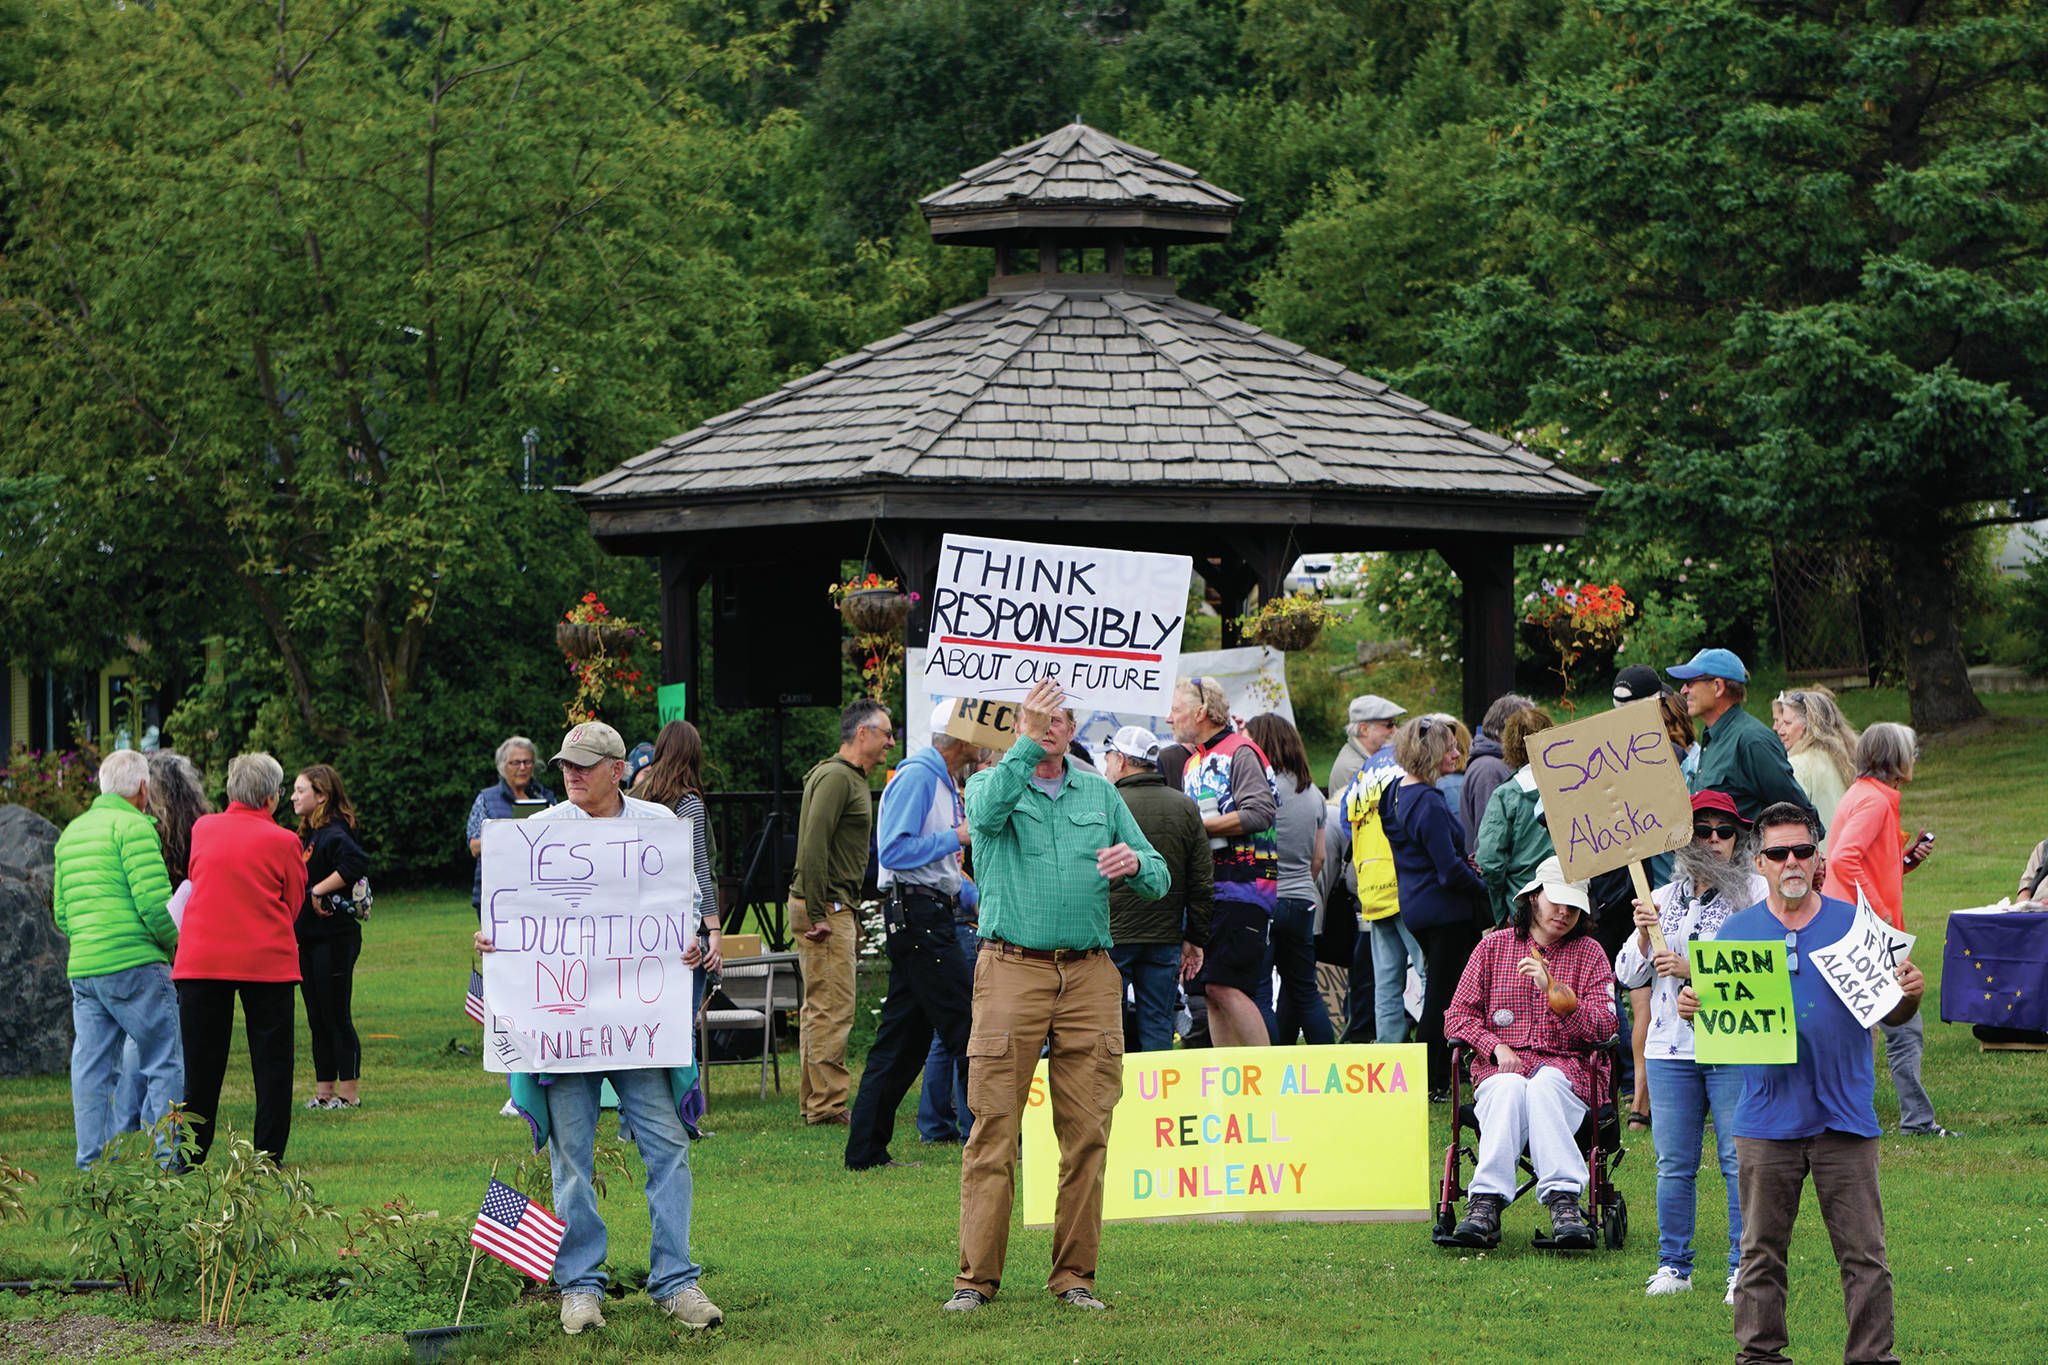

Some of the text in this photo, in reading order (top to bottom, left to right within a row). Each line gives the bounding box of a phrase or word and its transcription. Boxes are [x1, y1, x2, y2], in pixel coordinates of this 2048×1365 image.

[946, 544, 1097, 596] THINK
[930, 588, 1182, 651] RESPONSIBLY
[925, 646, 1161, 692] ABOUT OUR FUTURE
[1543, 731, 1667, 792] Save
[516, 825, 665, 882] YES TO
[1569, 801, 1663, 863] Alaska
[490, 889, 685, 957] EDUCATION
[1863, 929, 1877, 951] IF
[536, 955, 665, 1004] NO TO
[1696, 949, 1774, 974] LARN
[1846, 944, 1891, 998] LOVE
[1714, 981, 1754, 1001] TA
[1817, 954, 1875, 1020] ALASKA
[499, 1015, 661, 1061] NLEAVY
[1700, 1006, 1787, 1035] VOAT!
[1139, 1062, 1409, 1100] UP FOR ALASKA
[1155, 1111, 1291, 1148] RECALL
[1133, 1162, 1307, 1200] DUNLEAVY
